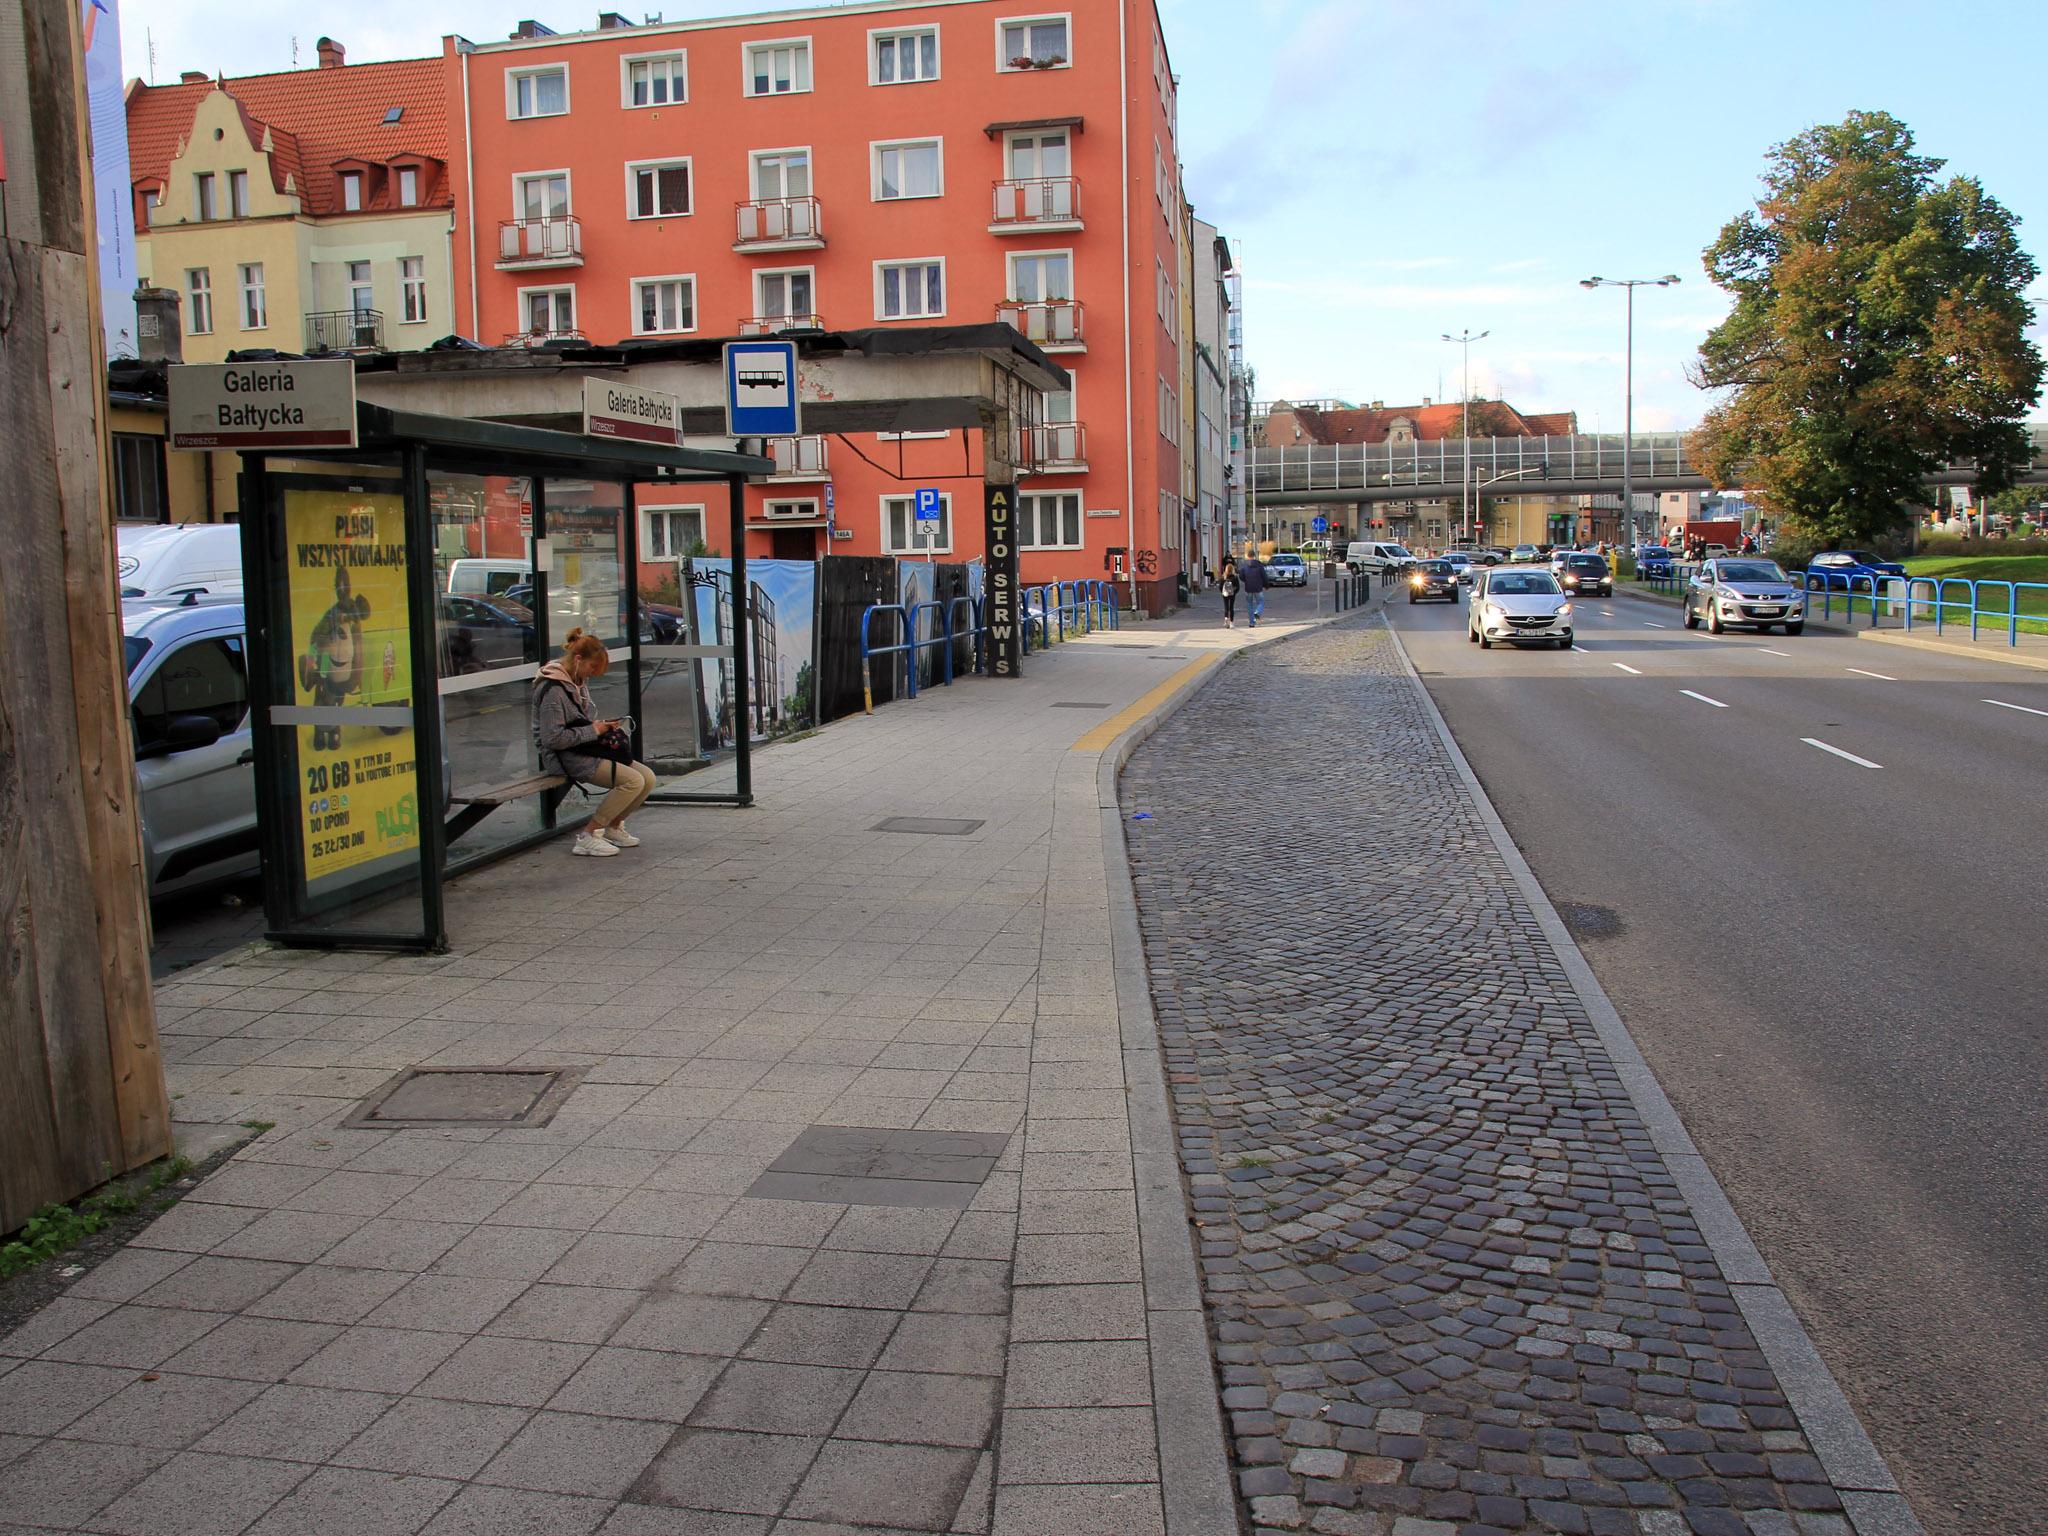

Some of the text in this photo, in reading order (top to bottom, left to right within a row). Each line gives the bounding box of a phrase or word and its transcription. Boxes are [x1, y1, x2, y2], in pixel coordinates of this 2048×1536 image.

[224, 369, 294, 392] Galeria
[218, 403, 304, 430] Bałtycka
[608, 390, 672, 423] Galeria Bałtycka
[591, 418, 615, 433] Wrzeszcz
[176, 435, 218, 446] Wrzeszcz
[921, 492, 934, 511] P
[991, 491, 1012, 674] AUTO SERWIS
[308, 760, 350, 794] 20 GB
[355, 772, 365, 784] NA
[366, 766, 392, 781] YOUTUBE
[310, 811, 349, 833] DO OPORU
[312, 842, 324, 858] 25
[352, 831, 365, 846] DNI
